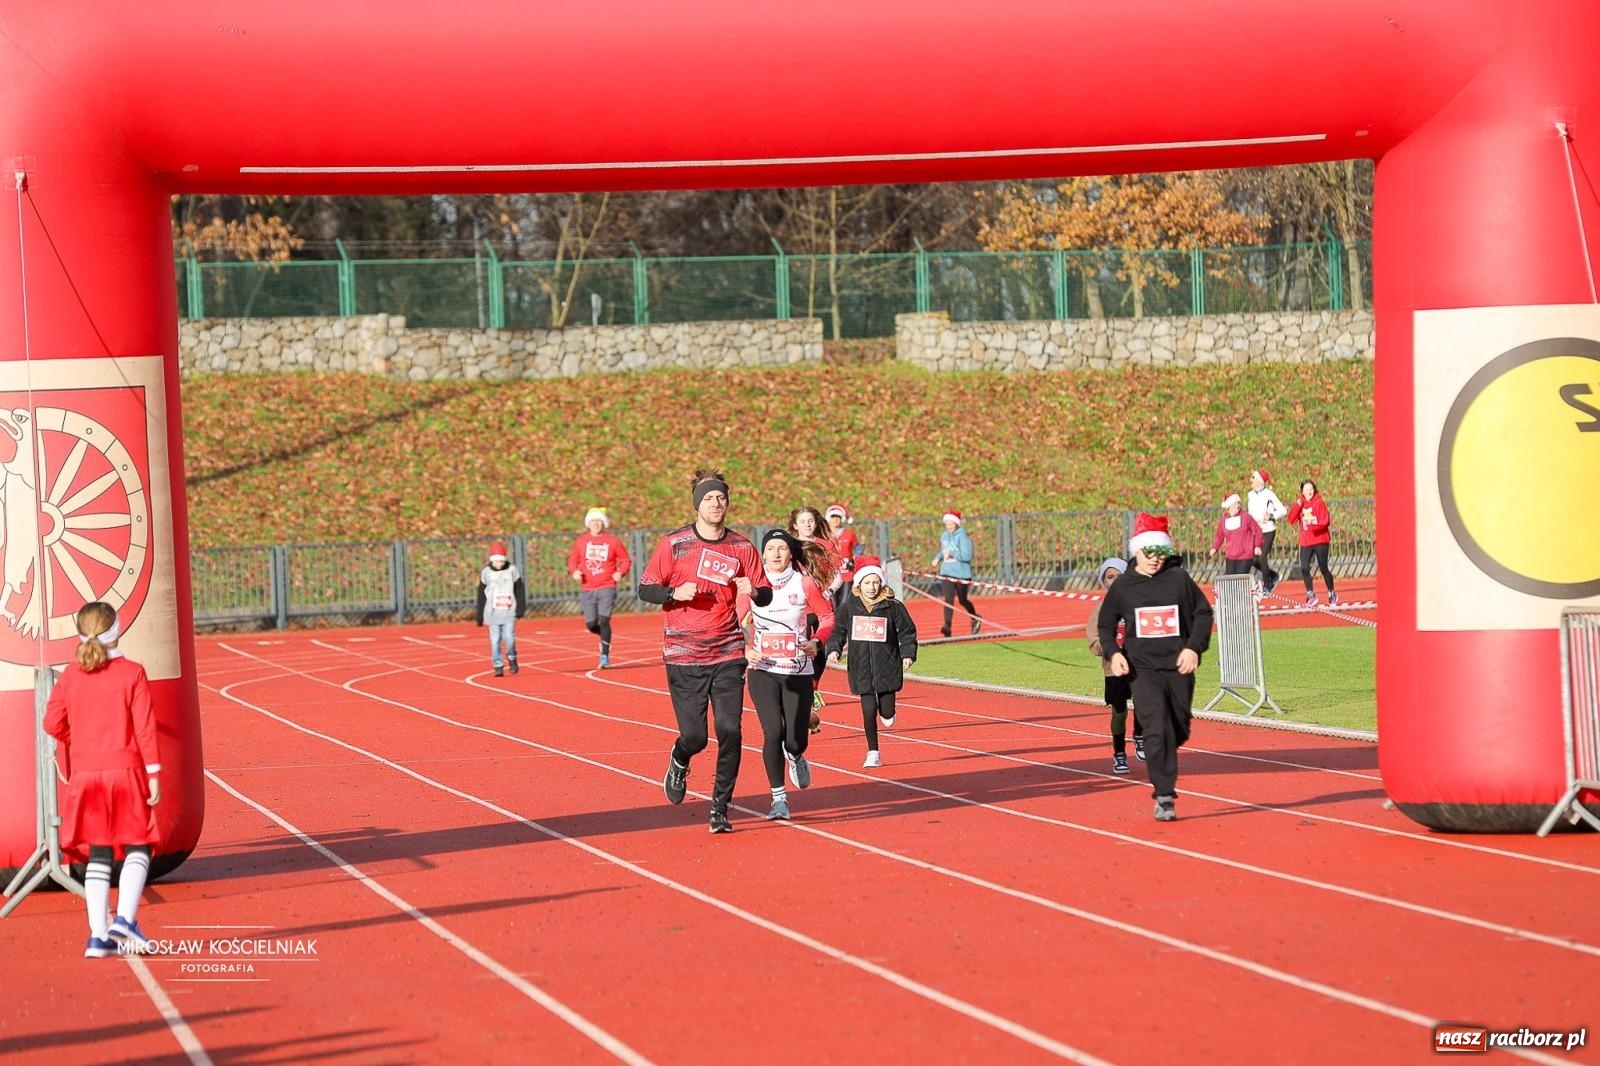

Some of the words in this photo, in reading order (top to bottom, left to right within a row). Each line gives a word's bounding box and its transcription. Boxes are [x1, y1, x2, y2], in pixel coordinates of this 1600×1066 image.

[712, 560, 728, 575] 92
[1153, 615, 1163, 628] 3
[772, 639, 785, 651] 31
